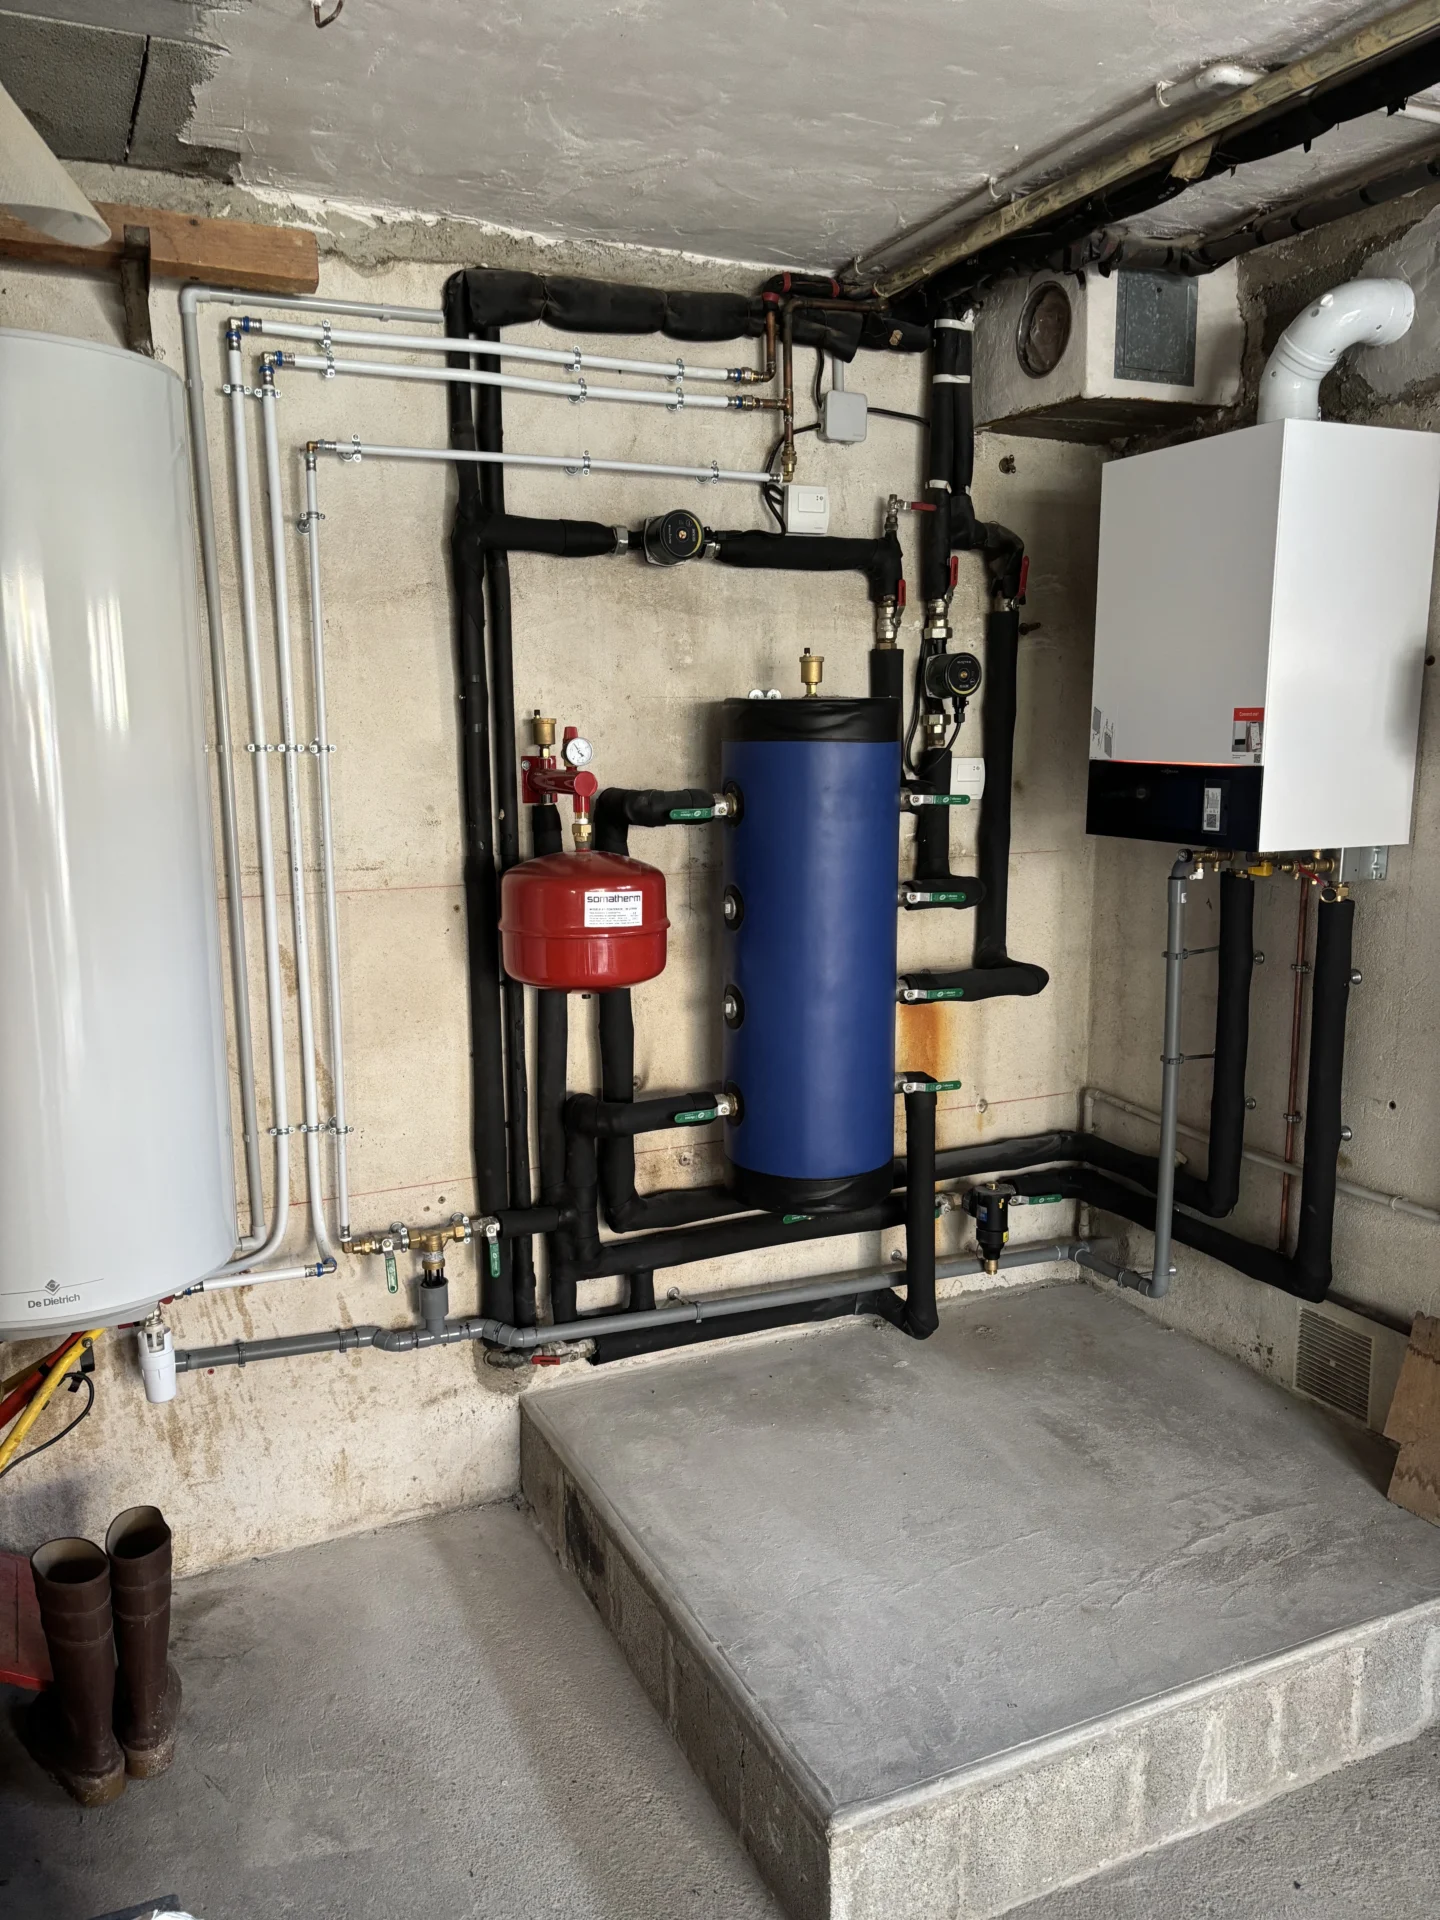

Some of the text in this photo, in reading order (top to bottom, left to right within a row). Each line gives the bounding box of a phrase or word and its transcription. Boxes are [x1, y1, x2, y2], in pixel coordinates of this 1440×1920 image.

[587, 894, 641, 903] somatherm
[28, 1294, 81, 1308] De Dietrich
